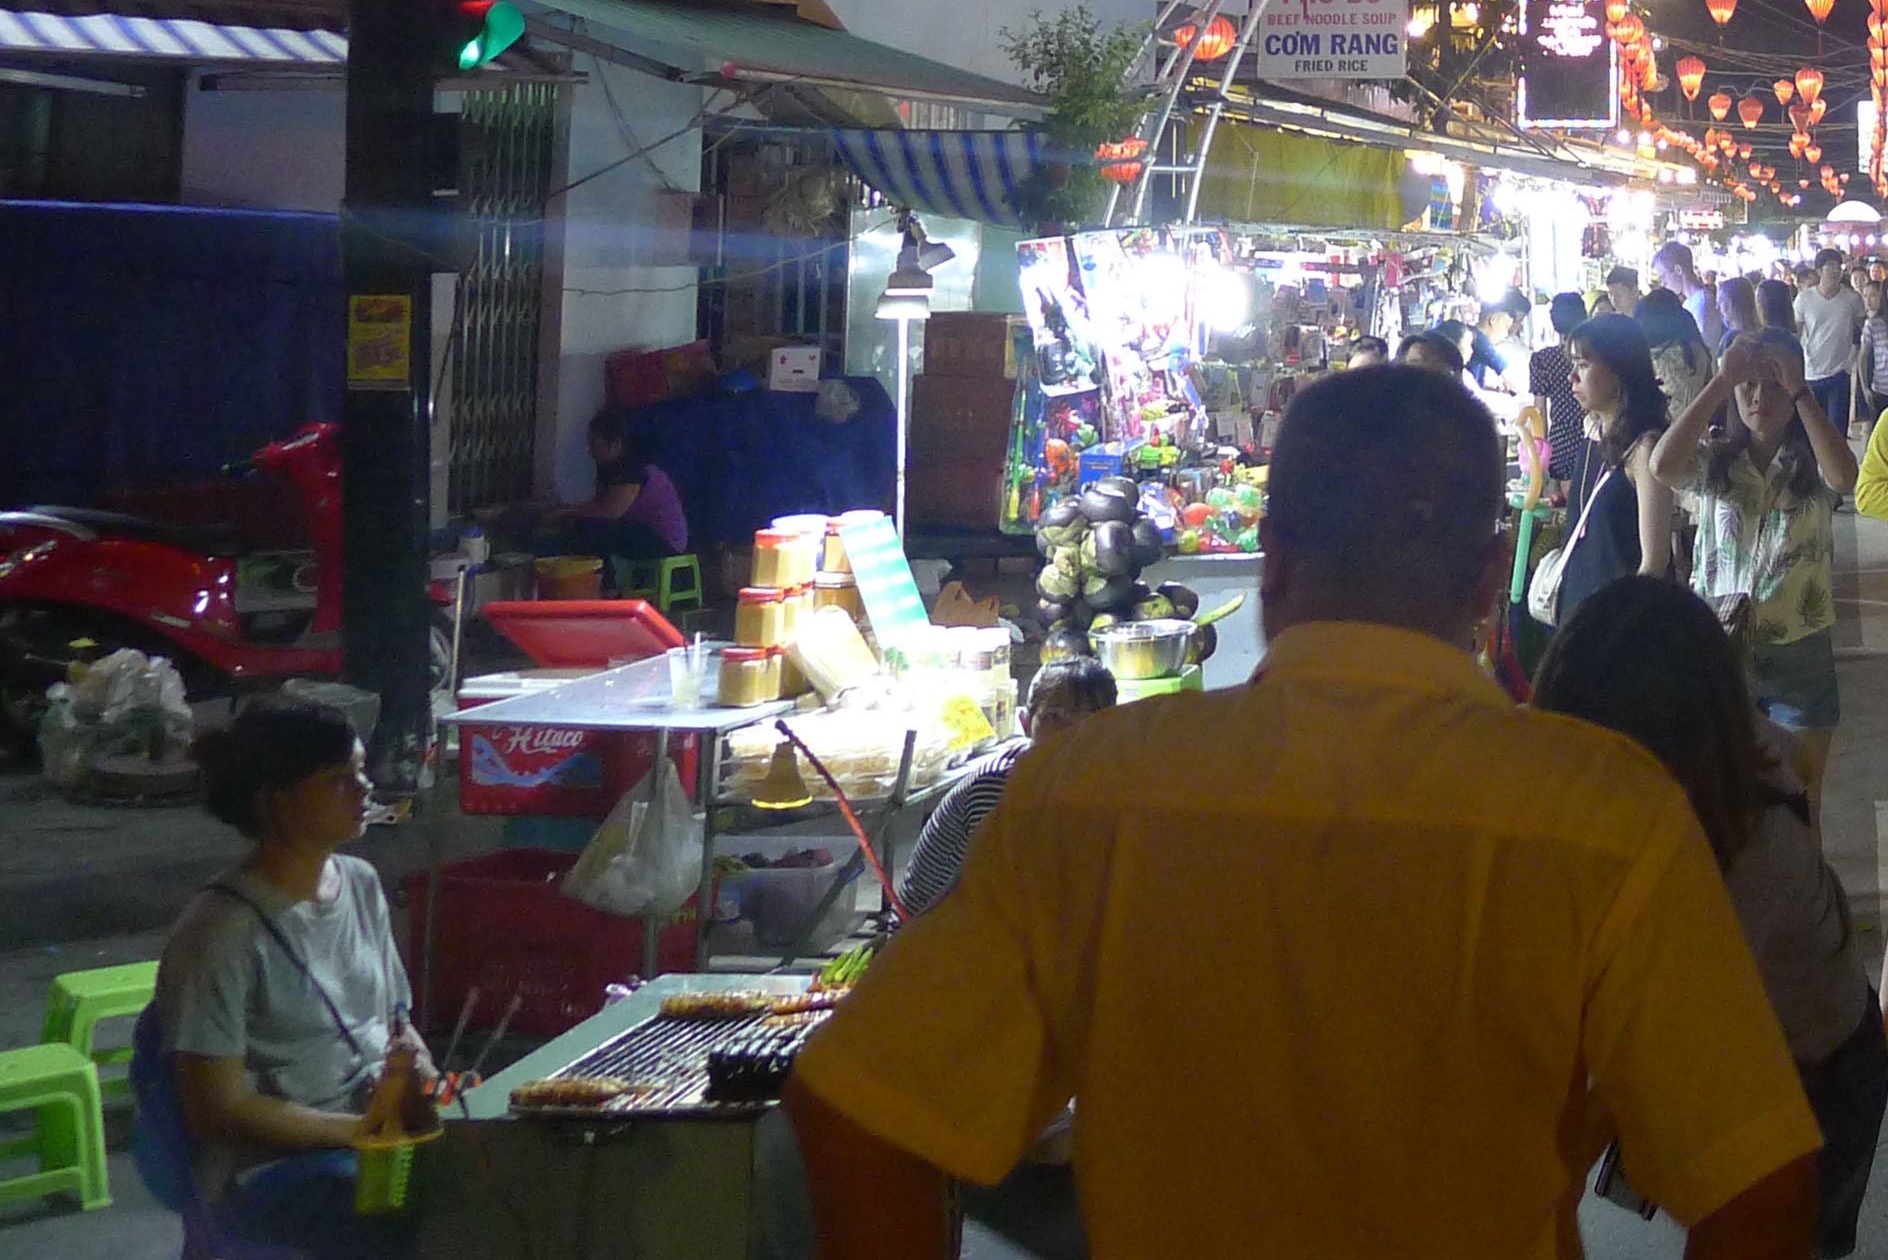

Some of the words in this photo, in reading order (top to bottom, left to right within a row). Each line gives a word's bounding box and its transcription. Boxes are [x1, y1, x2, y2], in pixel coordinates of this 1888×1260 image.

[1267, 13, 1302, 26] BEEF
[1305, 13, 1357, 26] NOODLE
[1362, 12, 1397, 26] SOUP
[1264, 30, 1321, 56] CƠM
[1330, 32, 1399, 56] RANG
[1294, 59, 1334, 72] FRIED
[1338, 59, 1369, 72] RICE
